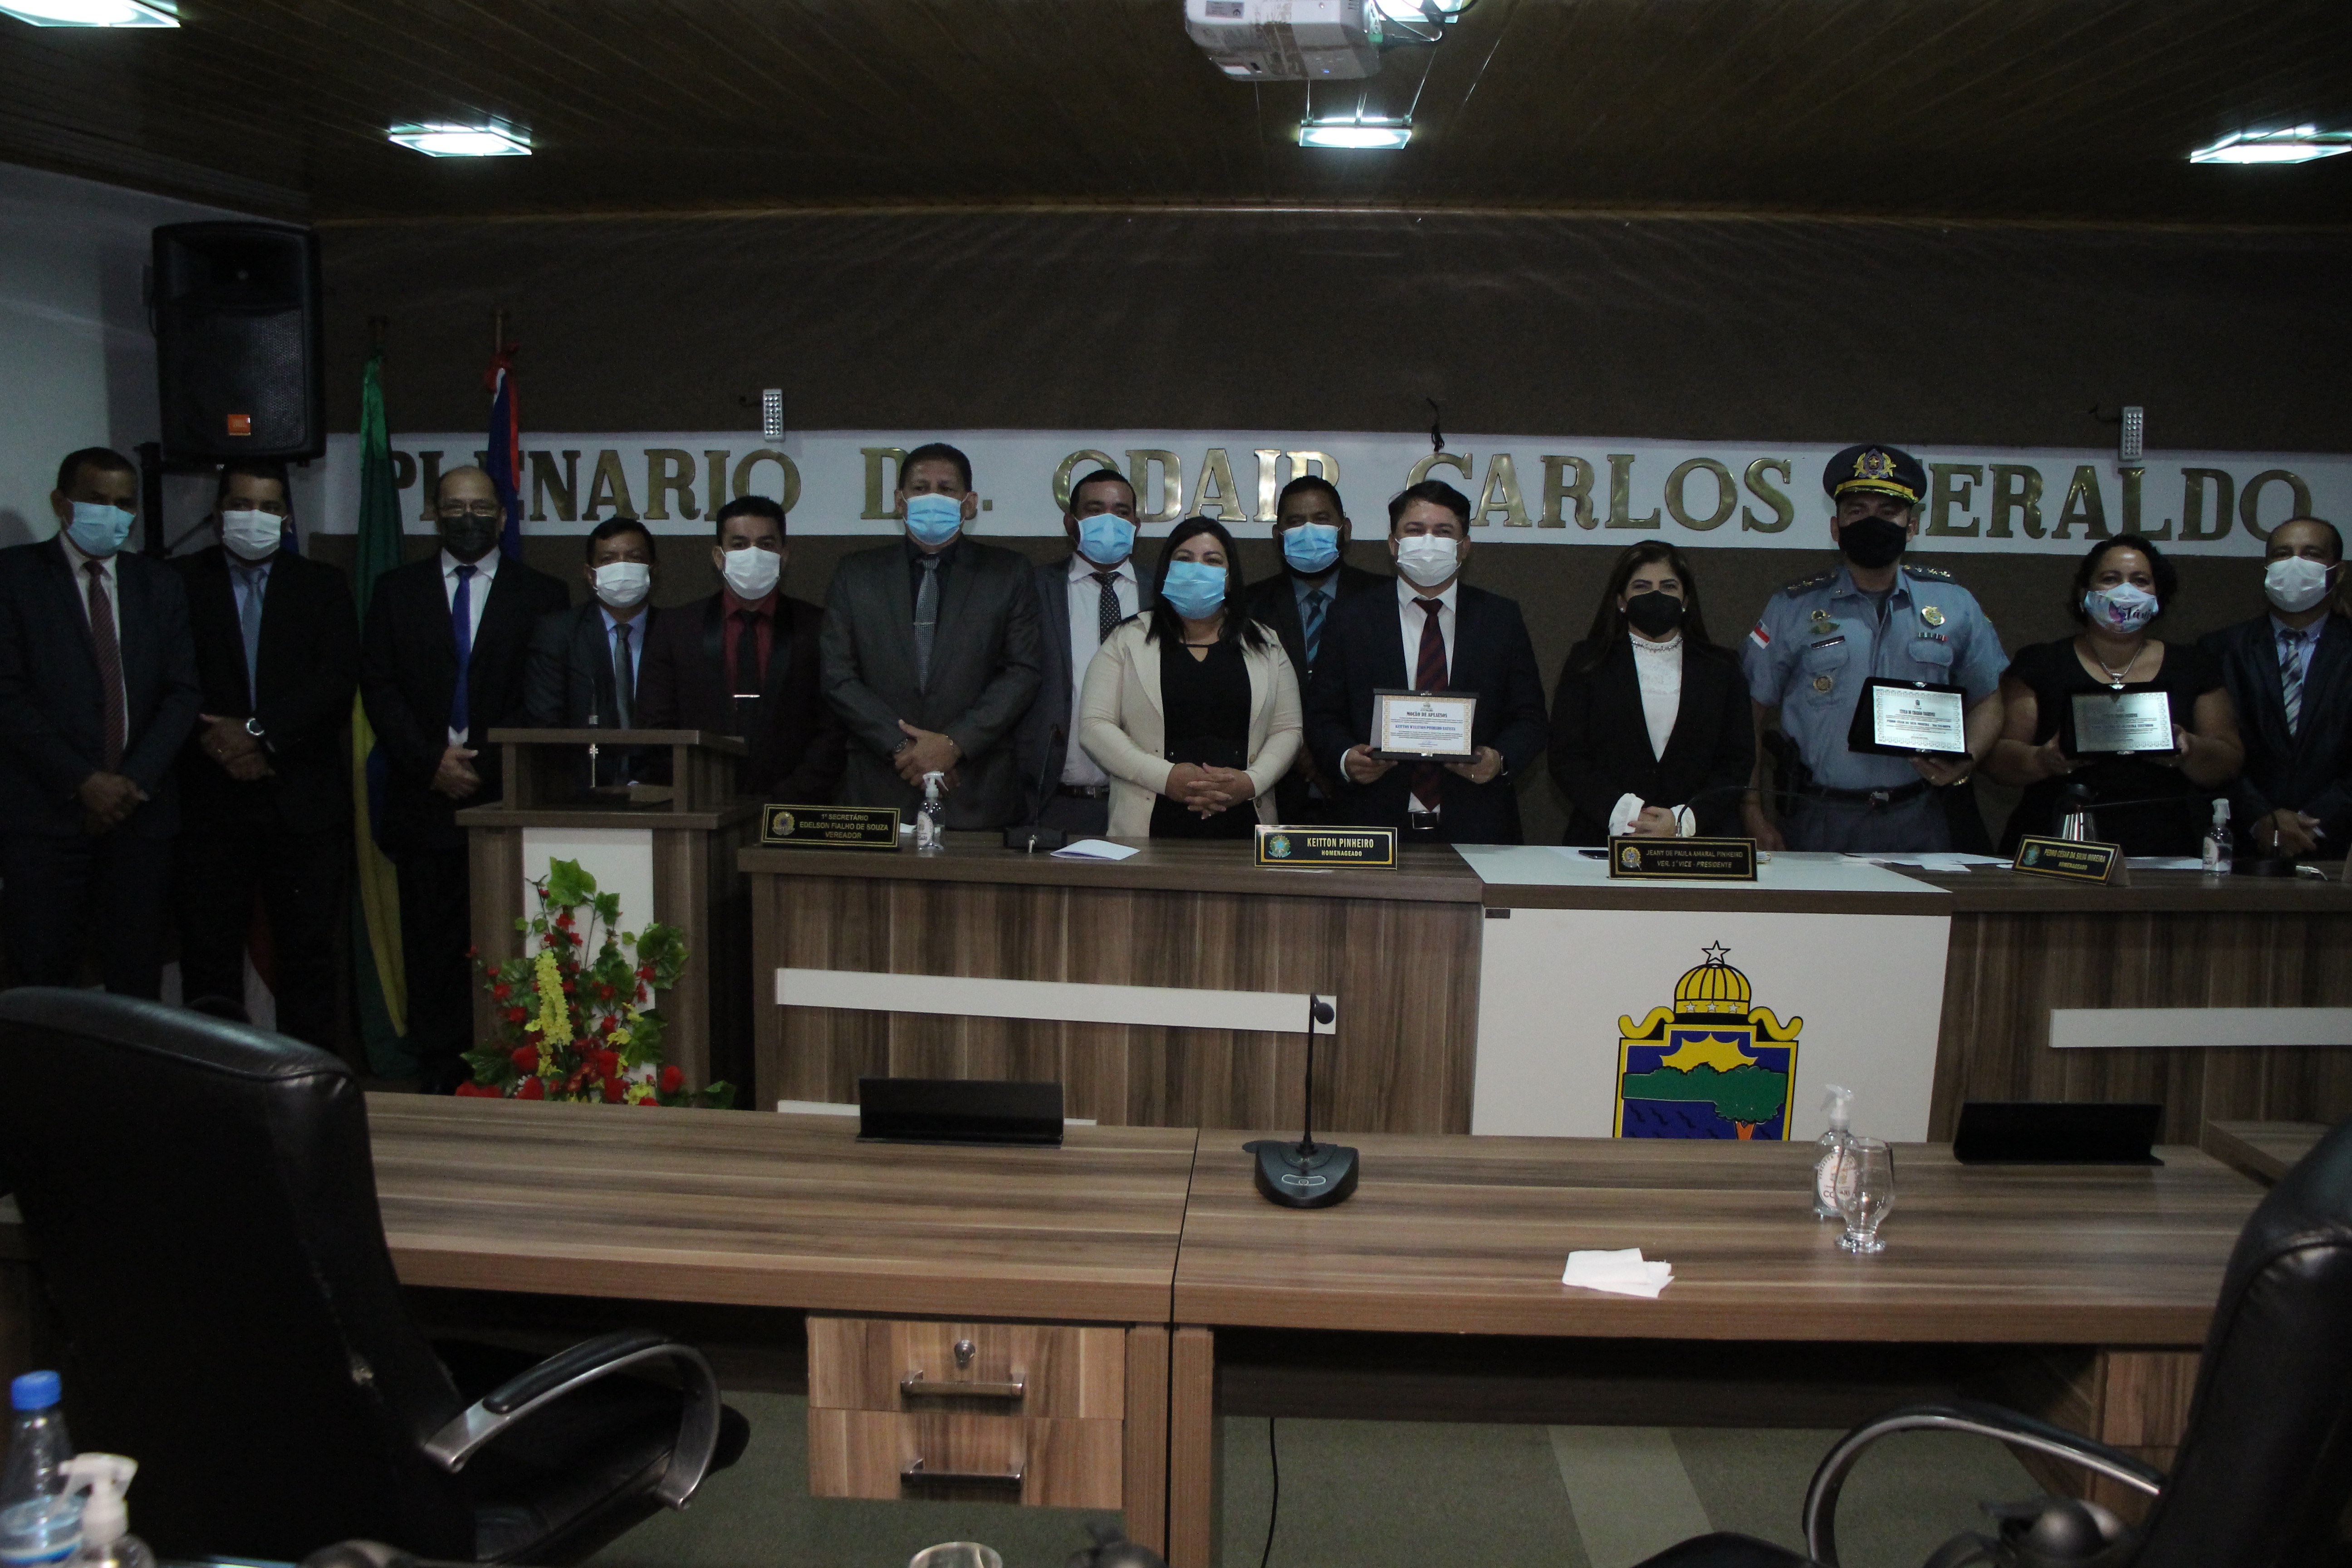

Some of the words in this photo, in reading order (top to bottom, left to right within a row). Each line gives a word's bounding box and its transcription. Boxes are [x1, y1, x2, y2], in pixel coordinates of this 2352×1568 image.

[1912, 459, 2312, 541] ERALDO
[1307, 838, 1337, 847] KEITTON
[1339, 838, 1374, 848] PINHEIRO
